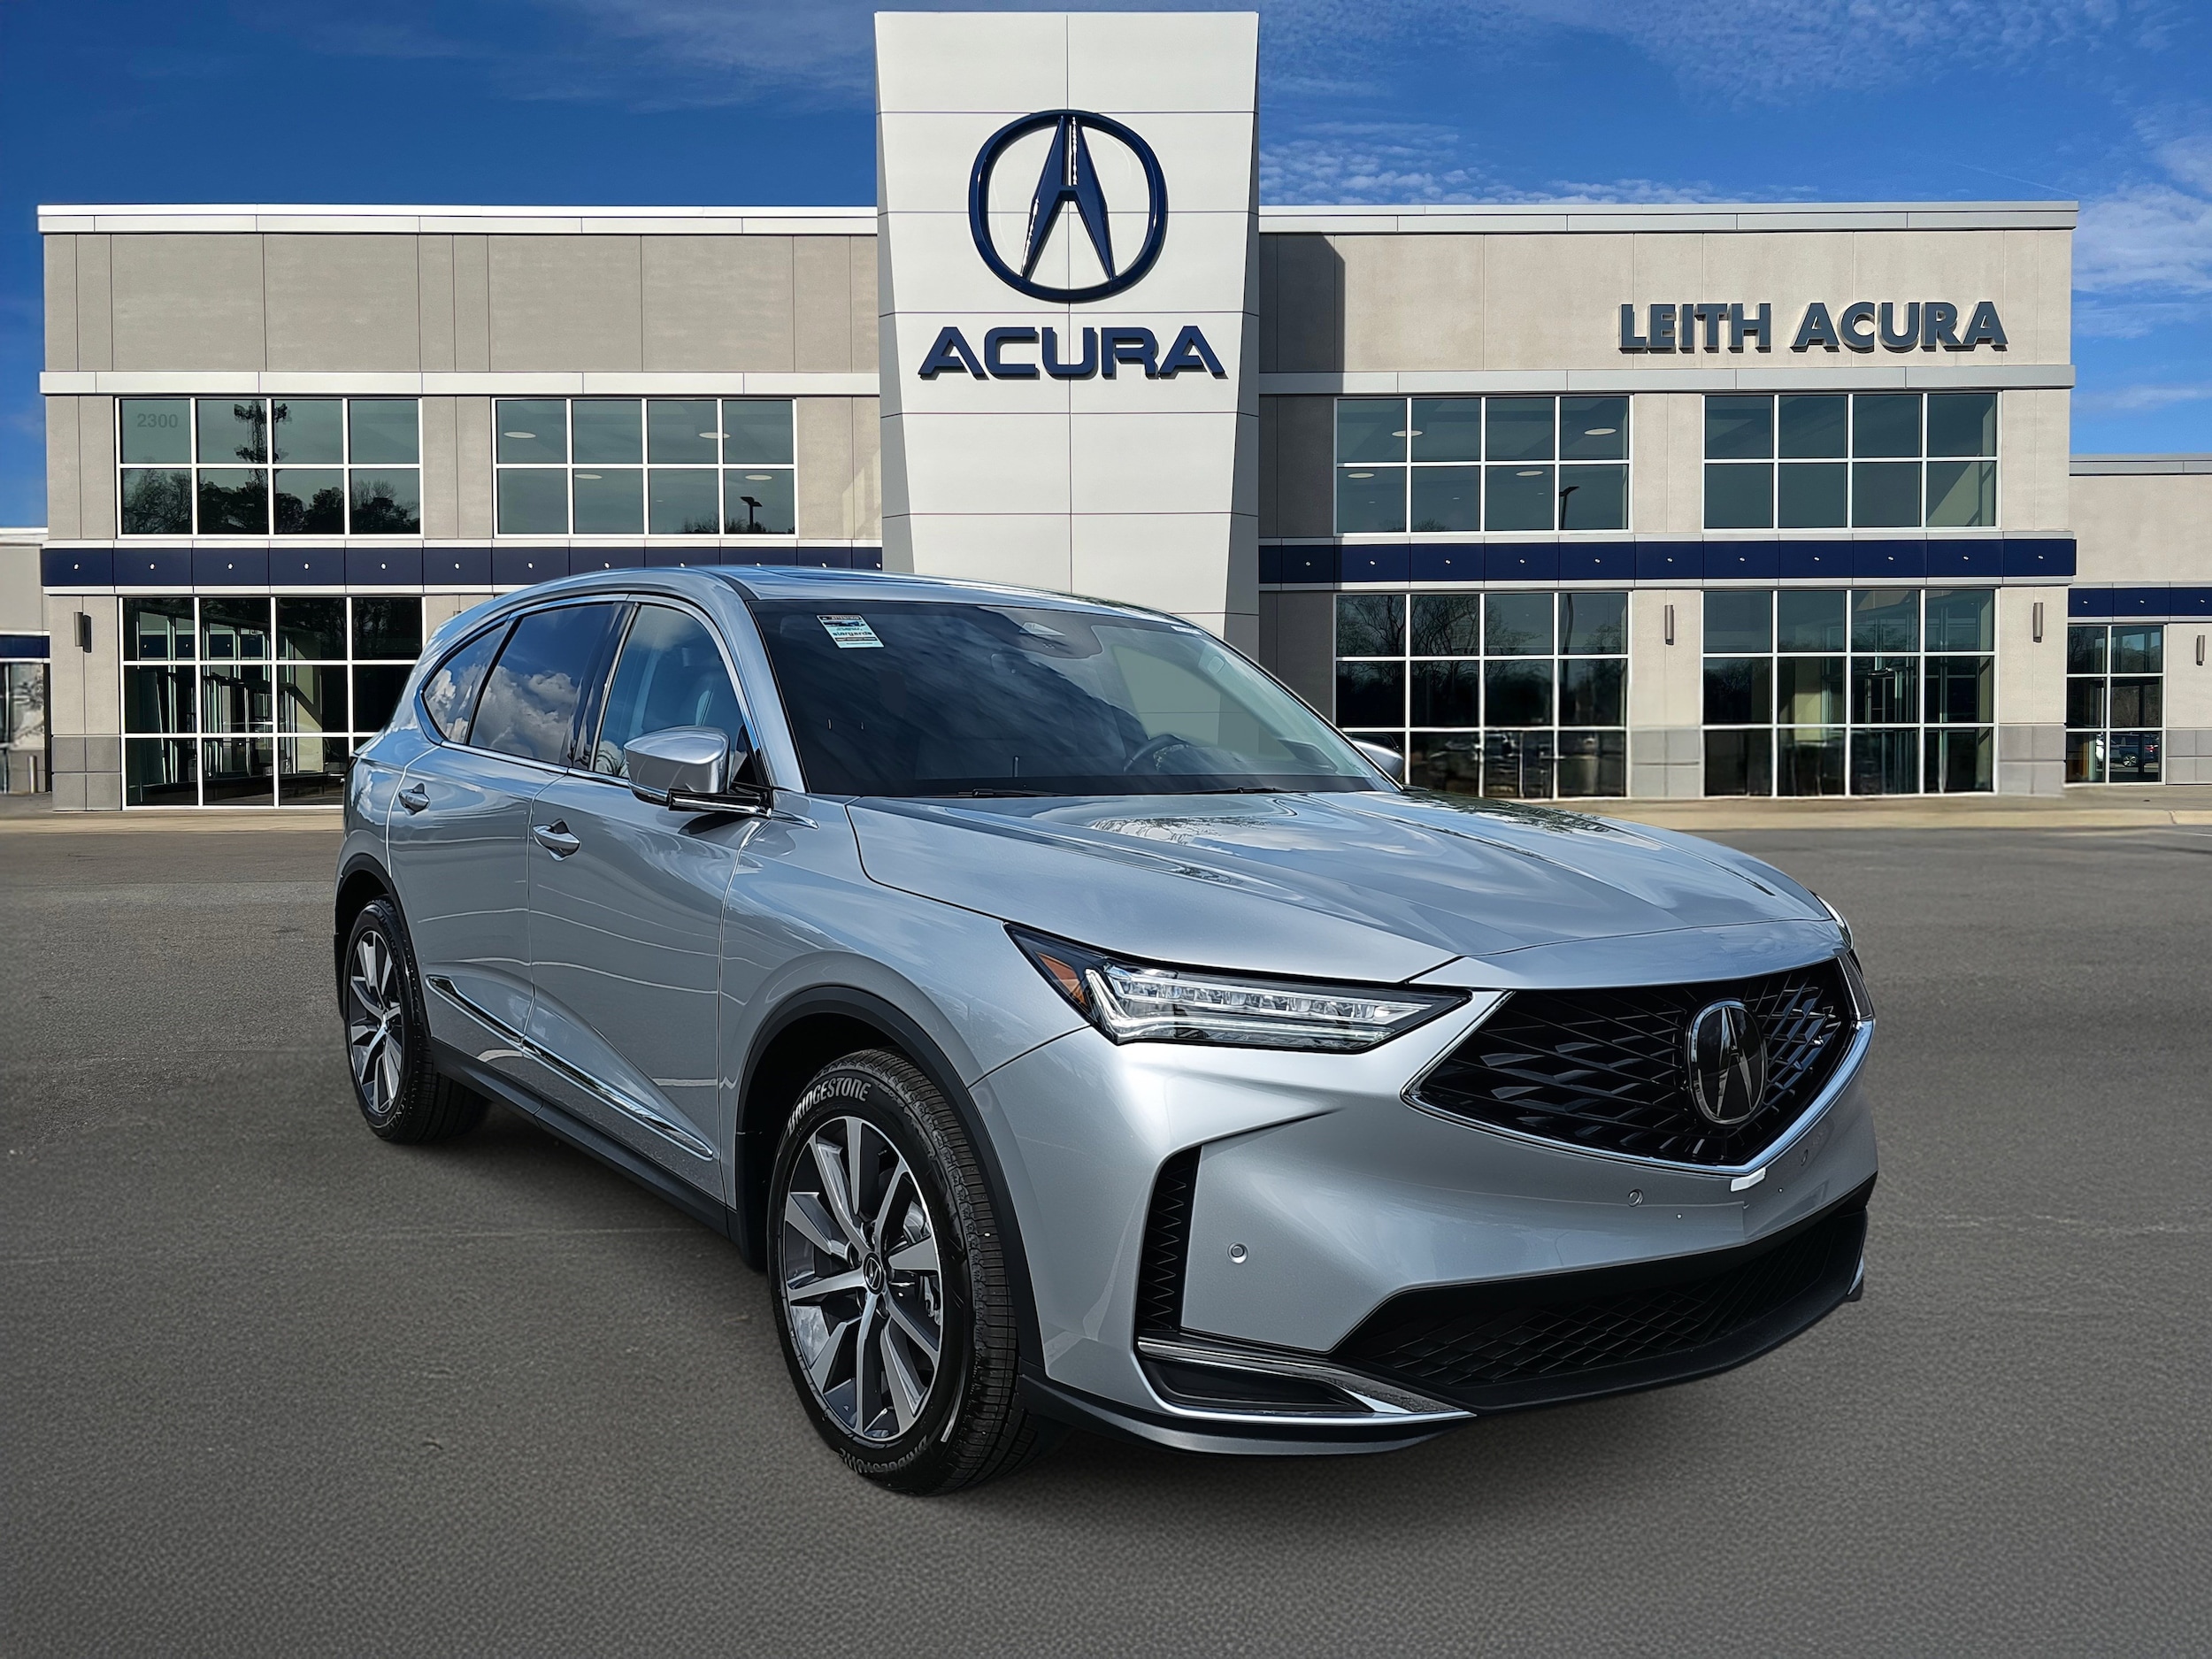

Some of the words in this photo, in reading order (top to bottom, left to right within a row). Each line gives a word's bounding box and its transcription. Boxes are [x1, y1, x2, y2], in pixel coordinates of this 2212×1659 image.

[918, 325, 1228, 380] ACURA
[1618, 303, 1770, 353] LEITH
[1789, 301, 2008, 353] ACURA
[136, 413, 179, 428] 2300
[787, 1077, 872, 1137] BRIDGESTONE
